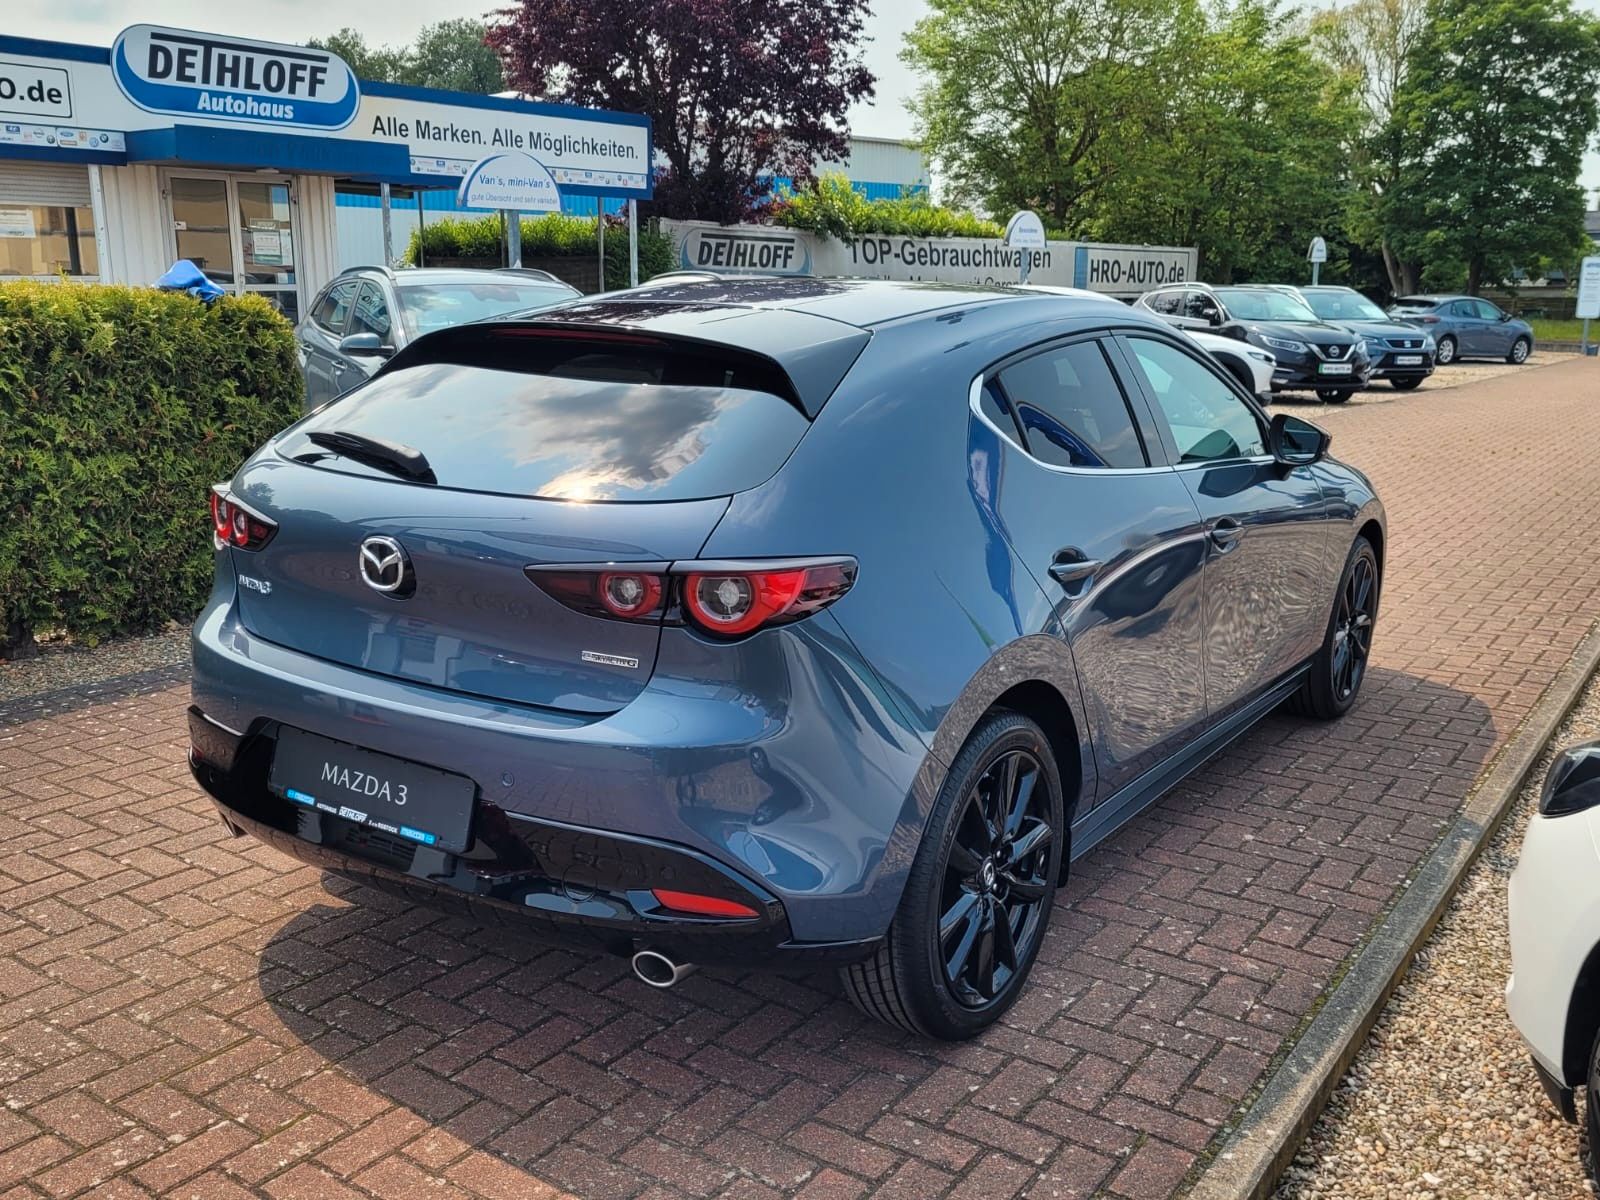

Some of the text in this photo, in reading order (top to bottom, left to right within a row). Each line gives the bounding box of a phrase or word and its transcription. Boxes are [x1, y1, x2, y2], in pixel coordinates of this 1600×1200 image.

[148, 32, 330, 98] DETHLOFF
[197, 91, 294, 119] Autohaus
[372, 115, 639, 160] Alle Marken. Alle Möglichkeiten.
[698, 233, 795, 269] DETHLOFF
[1090, 258, 1184, 283] HRO-AUTO.de
[321, 762, 391, 802] MAZDA
[394, 784, 408, 805] 3
[339, 805, 368, 823] DETHLOFF
